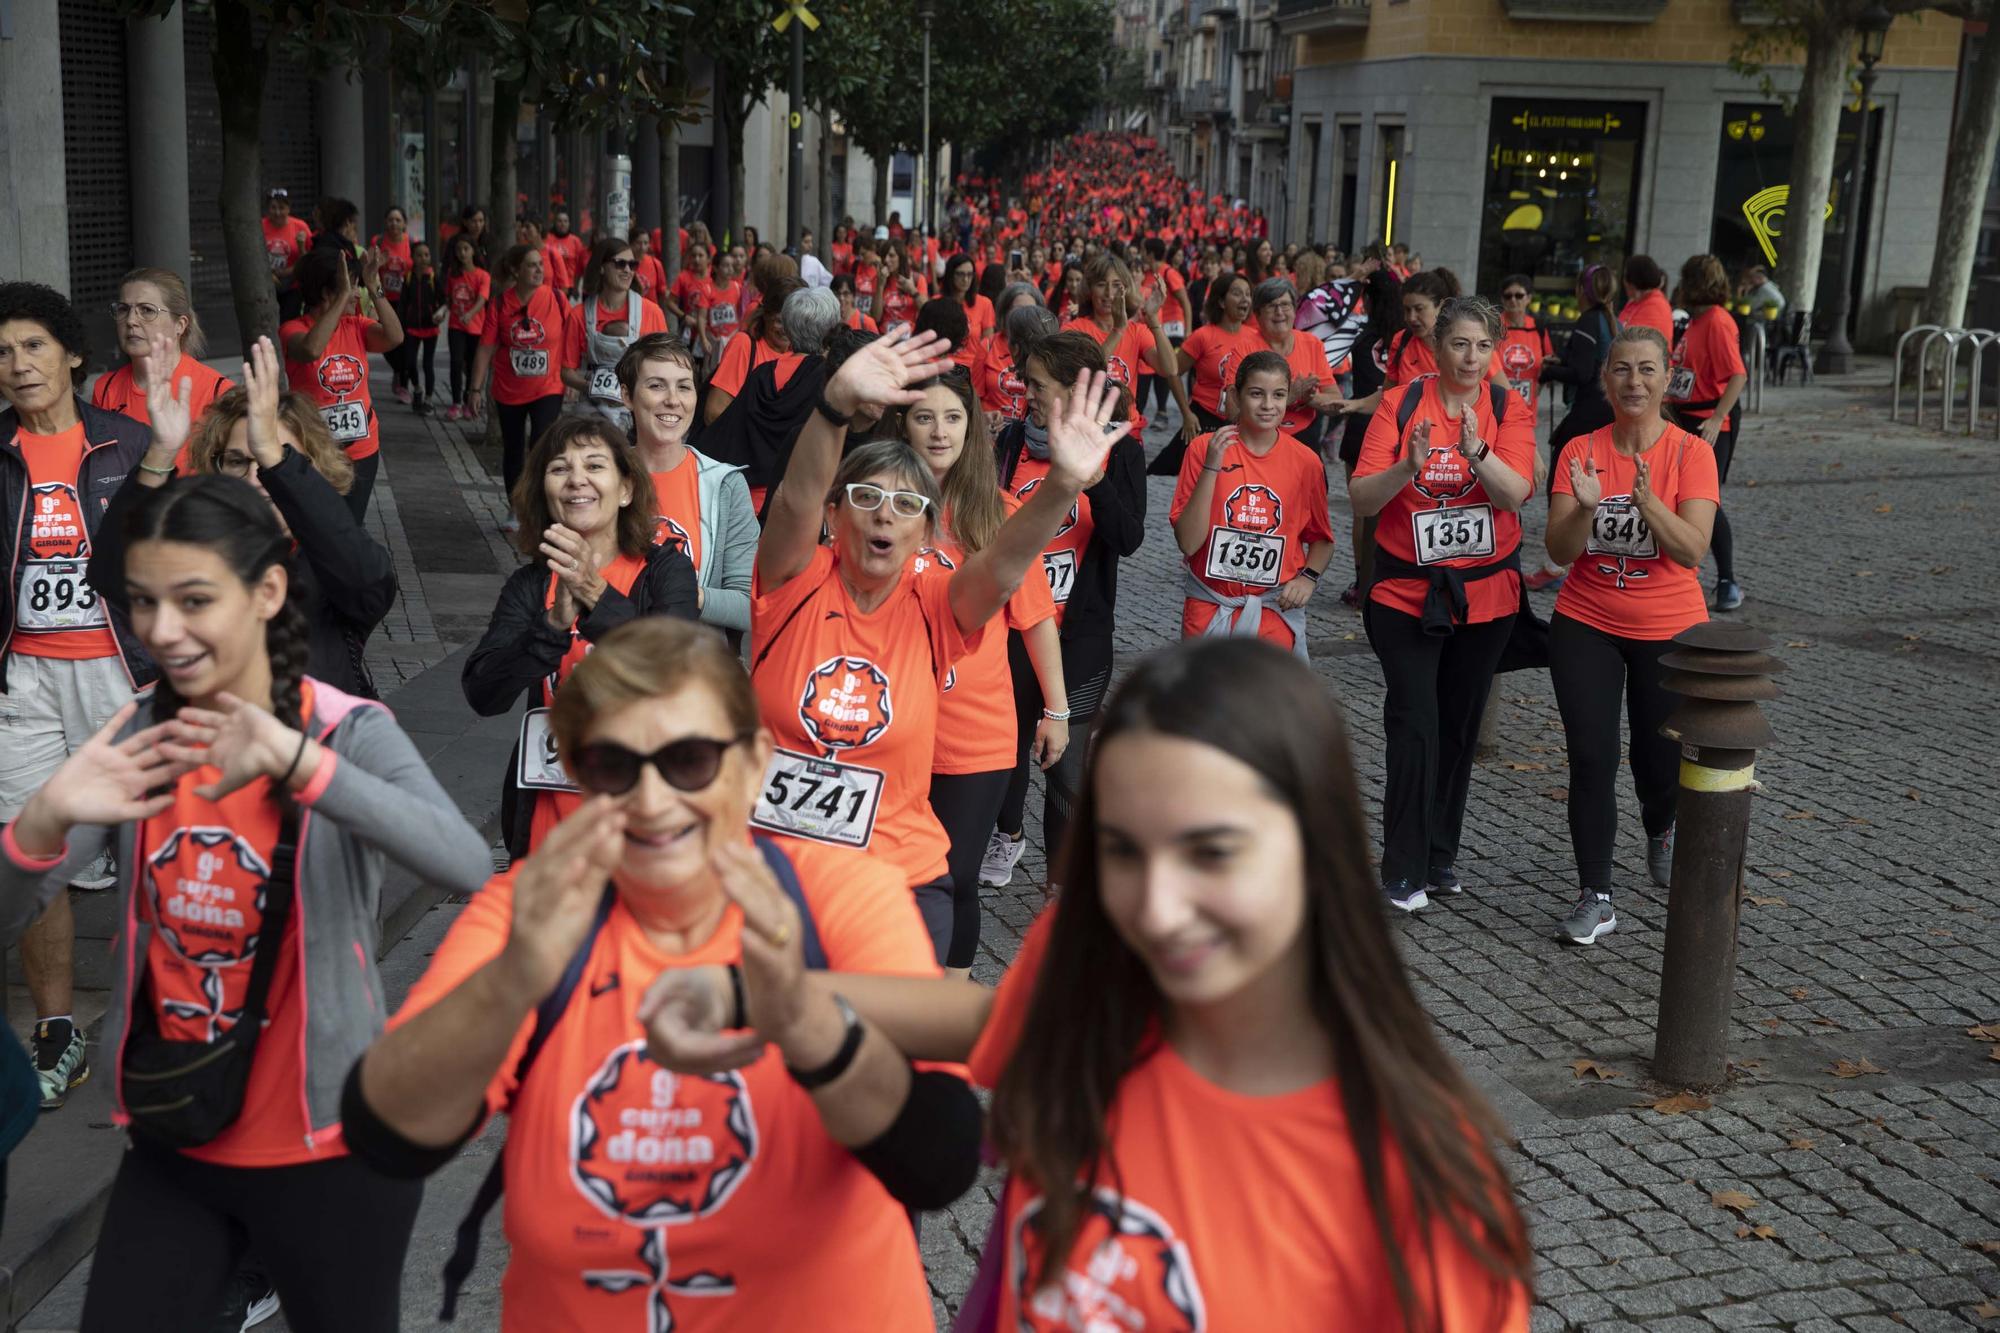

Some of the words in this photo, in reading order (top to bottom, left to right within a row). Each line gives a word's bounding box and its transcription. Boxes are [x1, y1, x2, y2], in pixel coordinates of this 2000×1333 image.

[515, 356, 546, 370] 1489
[328, 411, 360, 432] 545
[1425, 471, 1463, 482] dona
[1237, 512, 1268, 525] dona
[36, 539, 72, 547] GIRONA
[1424, 518, 1484, 549] 1351
[1218, 542, 1278, 572] 1350
[30, 578, 97, 612] 893
[818, 698, 870, 723] dona
[823, 719, 860, 733] GIRONA
[765, 769, 868, 824] 5741
[176, 878, 236, 902] cursa
[166, 894, 245, 929] dona
[605, 1129, 715, 1165] dona
